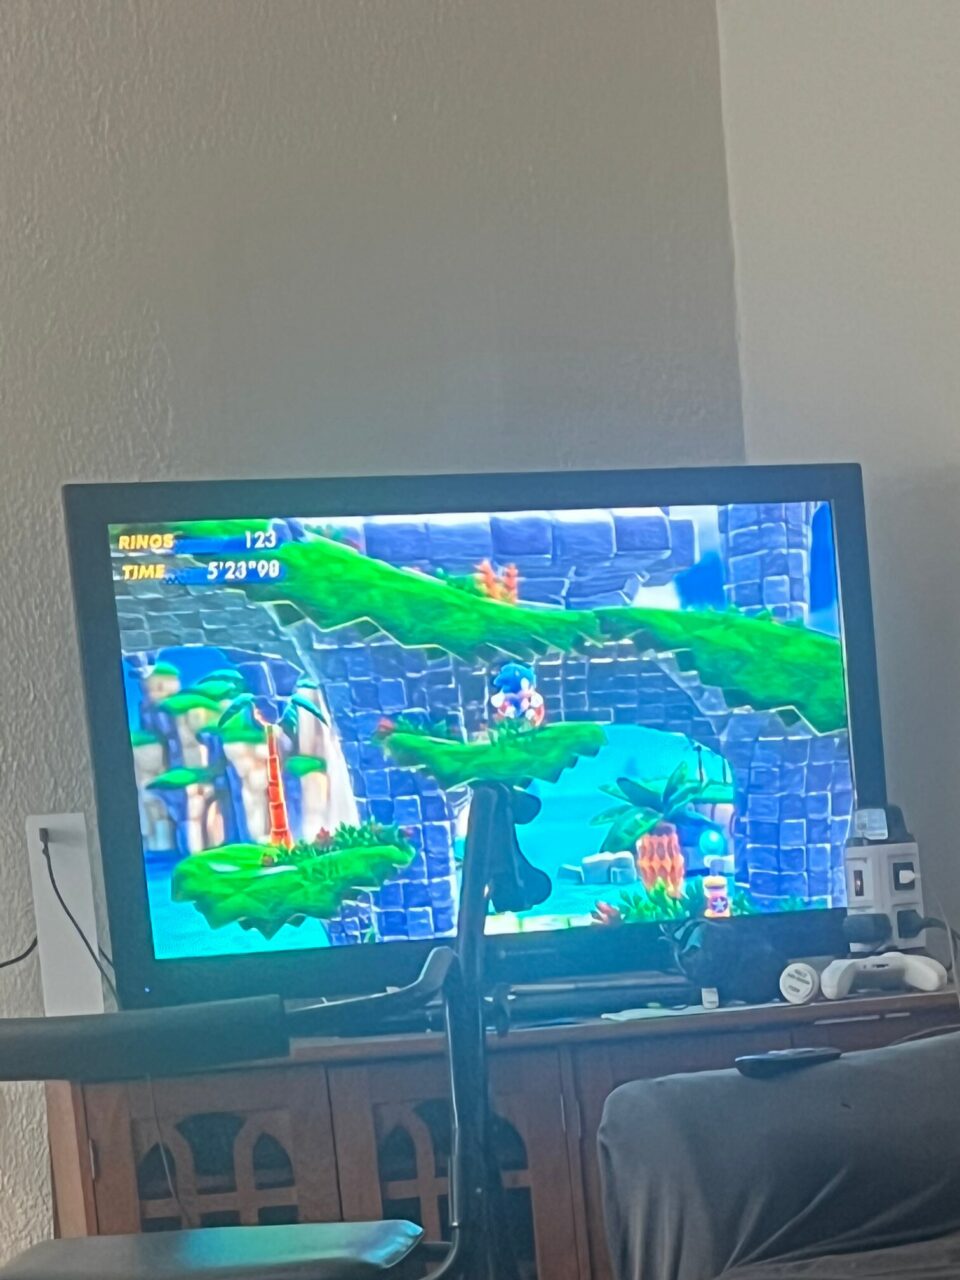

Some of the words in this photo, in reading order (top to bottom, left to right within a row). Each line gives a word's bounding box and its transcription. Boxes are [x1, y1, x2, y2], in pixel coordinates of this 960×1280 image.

[118, 533, 174, 550] RINGS
[245, 530, 277, 549] 123
[122, 563, 166, 580] TIME
